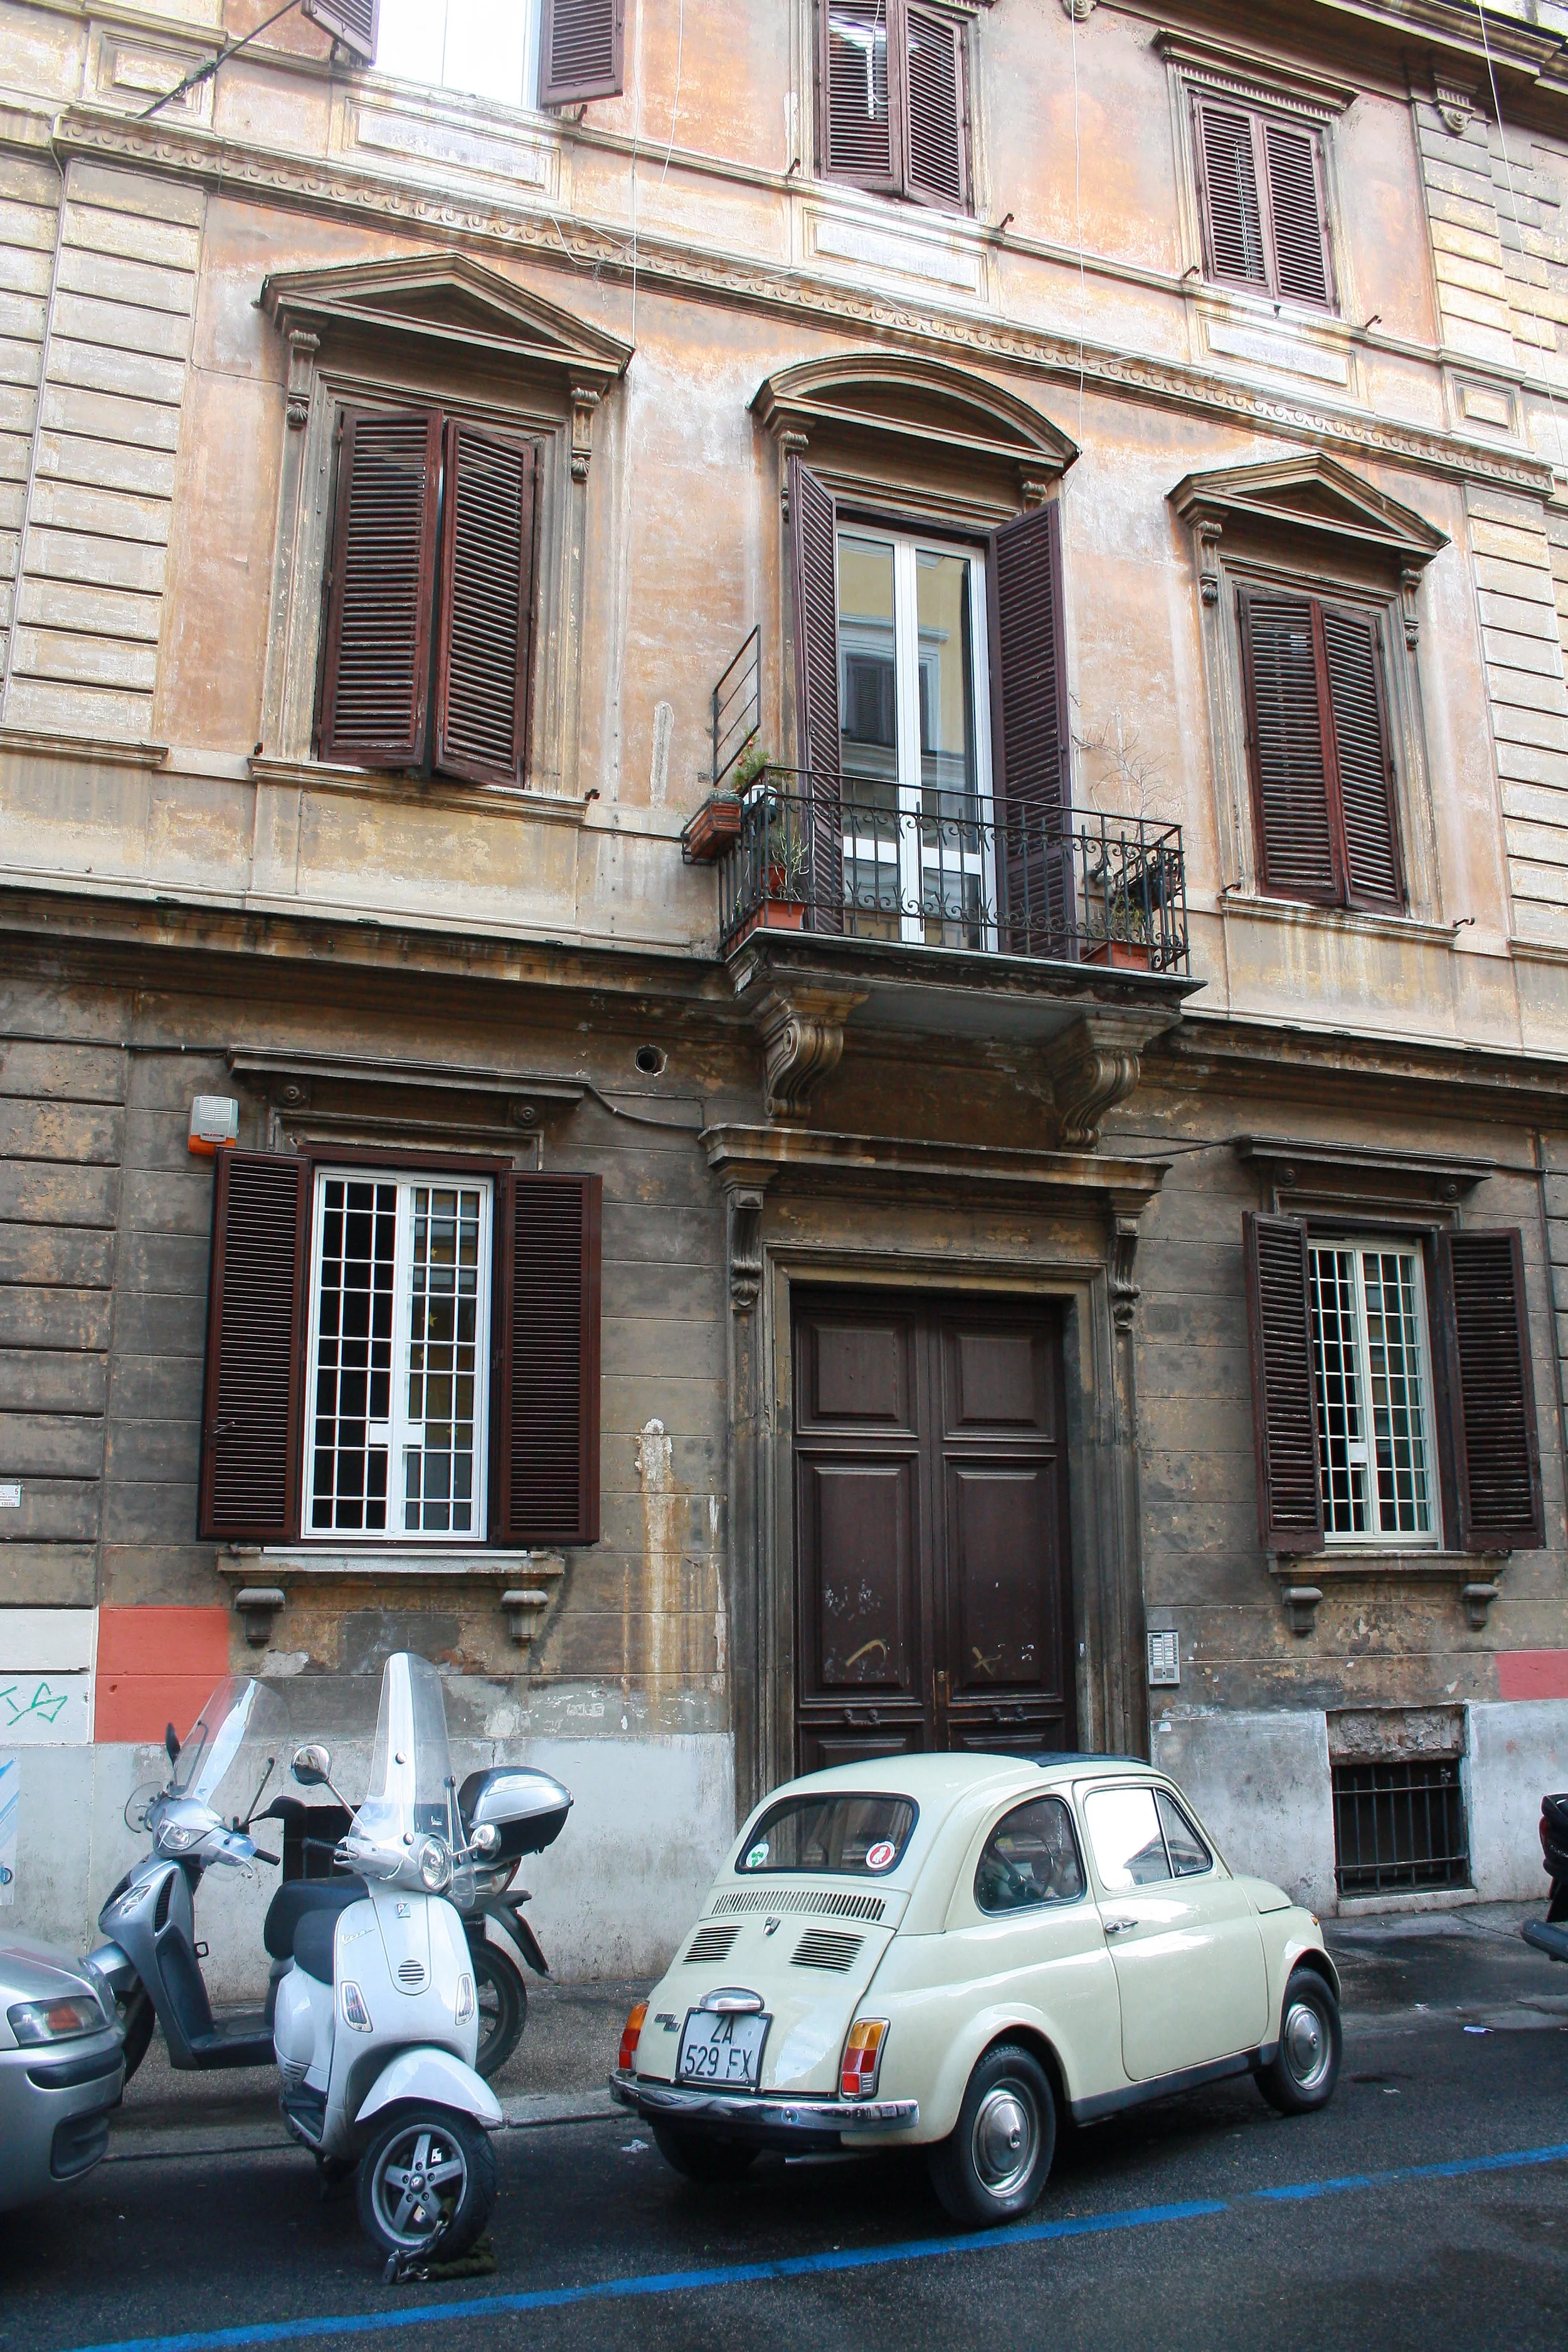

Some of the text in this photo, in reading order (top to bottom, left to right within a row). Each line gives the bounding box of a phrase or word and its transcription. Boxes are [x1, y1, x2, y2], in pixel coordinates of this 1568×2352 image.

[711, 2014, 734, 2045] ZA
[685, 2045, 752, 2079] 529 FX
